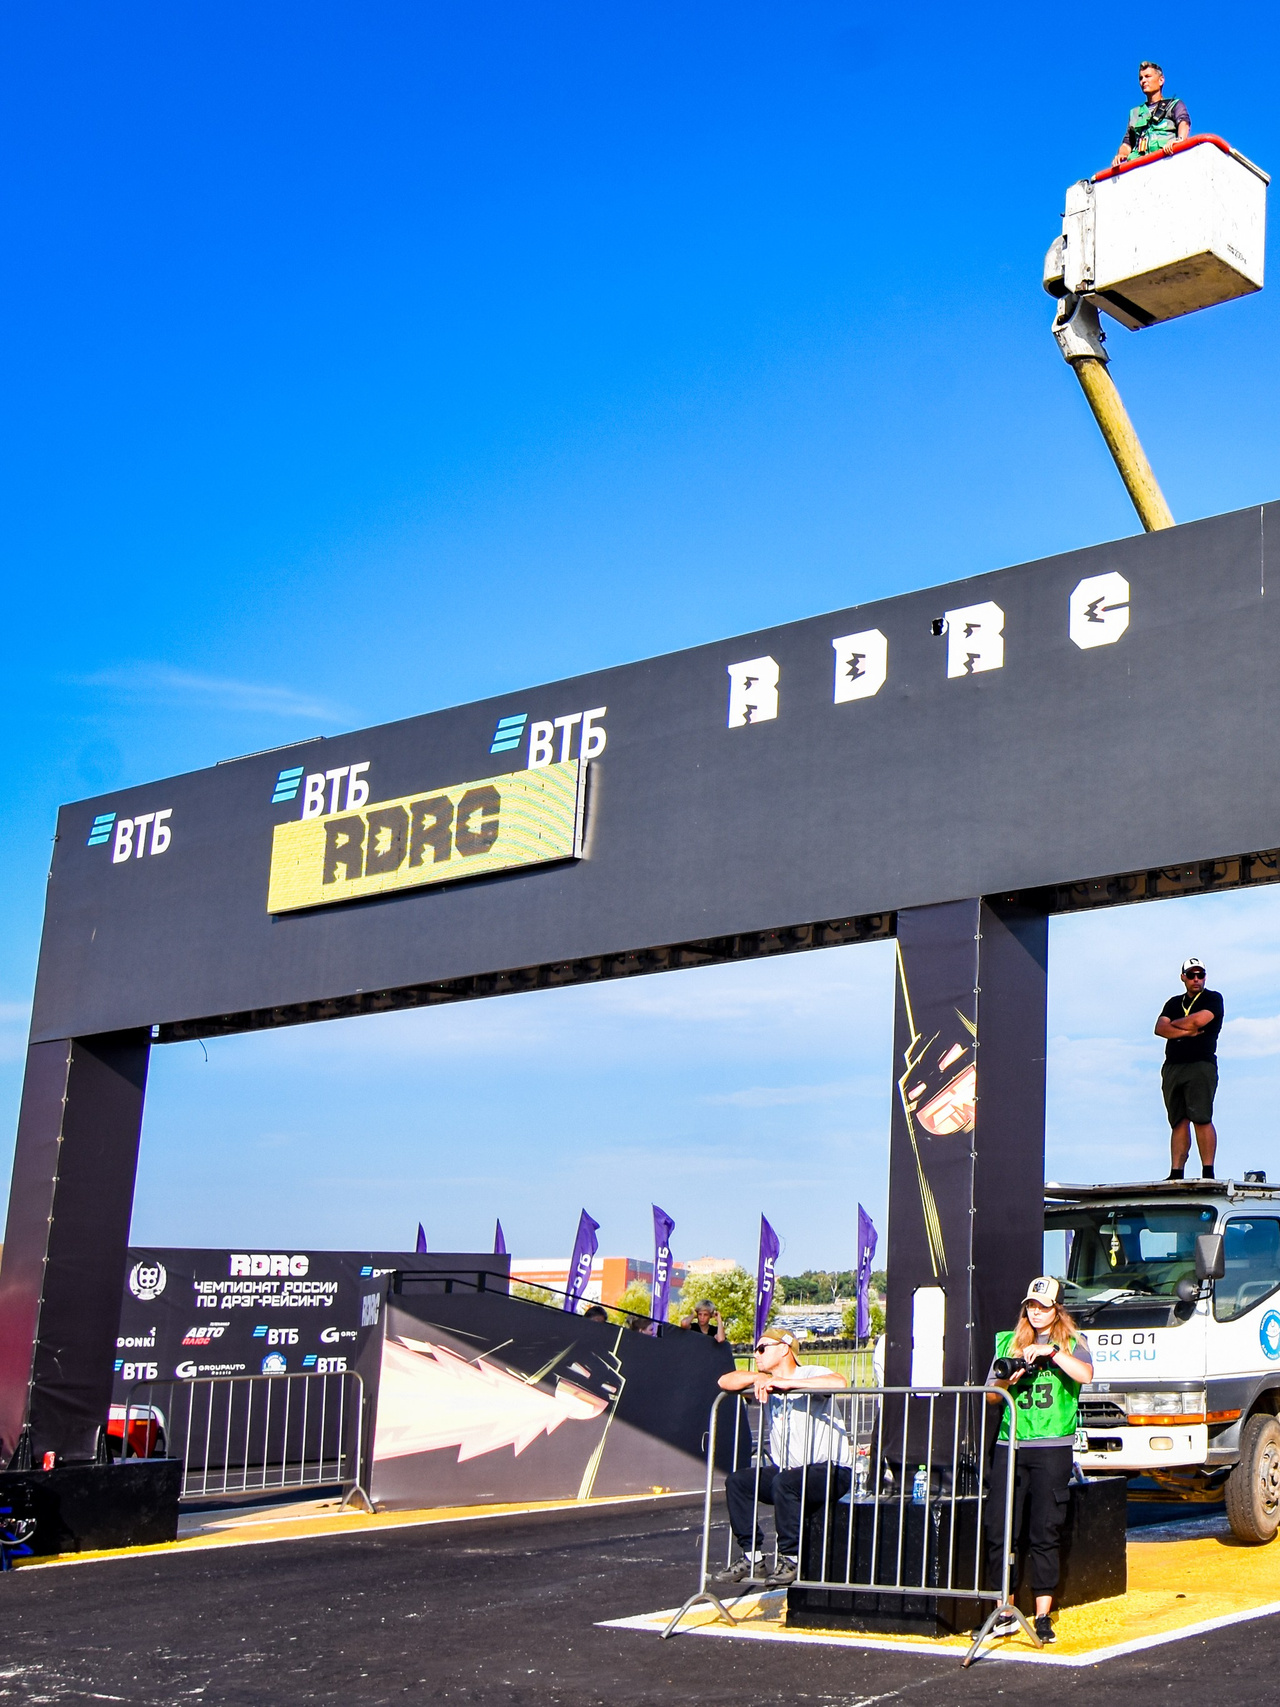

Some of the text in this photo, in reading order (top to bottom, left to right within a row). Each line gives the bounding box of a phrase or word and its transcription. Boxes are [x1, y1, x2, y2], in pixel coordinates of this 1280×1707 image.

[527, 706, 608, 770] ВТБ
[302, 761, 371, 820] ВТБ
[112, 808, 173, 864] ВТБ
[322, 784, 502, 885] RDRC
[229, 1254, 310, 1277] RDRC
[193, 1281, 338, 1294] ЧЕМПИОНАТ РОССИИ
[196, 1292, 334, 1309] ПО ДРЭГ-РЕЙСИНГУ
[185, 1327, 225, 1338] АВТО
[267, 1328, 299, 1345] ВТБ
[1098, 1333, 1156, 1346] 60 01
[181, 1337, 211, 1346] ПЛЮС
[1091, 1349, 1157, 1363] SK.RU
[122, 1362, 158, 1380] ВТБ
[198, 1363, 246, 1372] GROUPAUTO
[316, 1357, 347, 1373] ВТБ
[1017, 1383, 1054, 1410] 33
